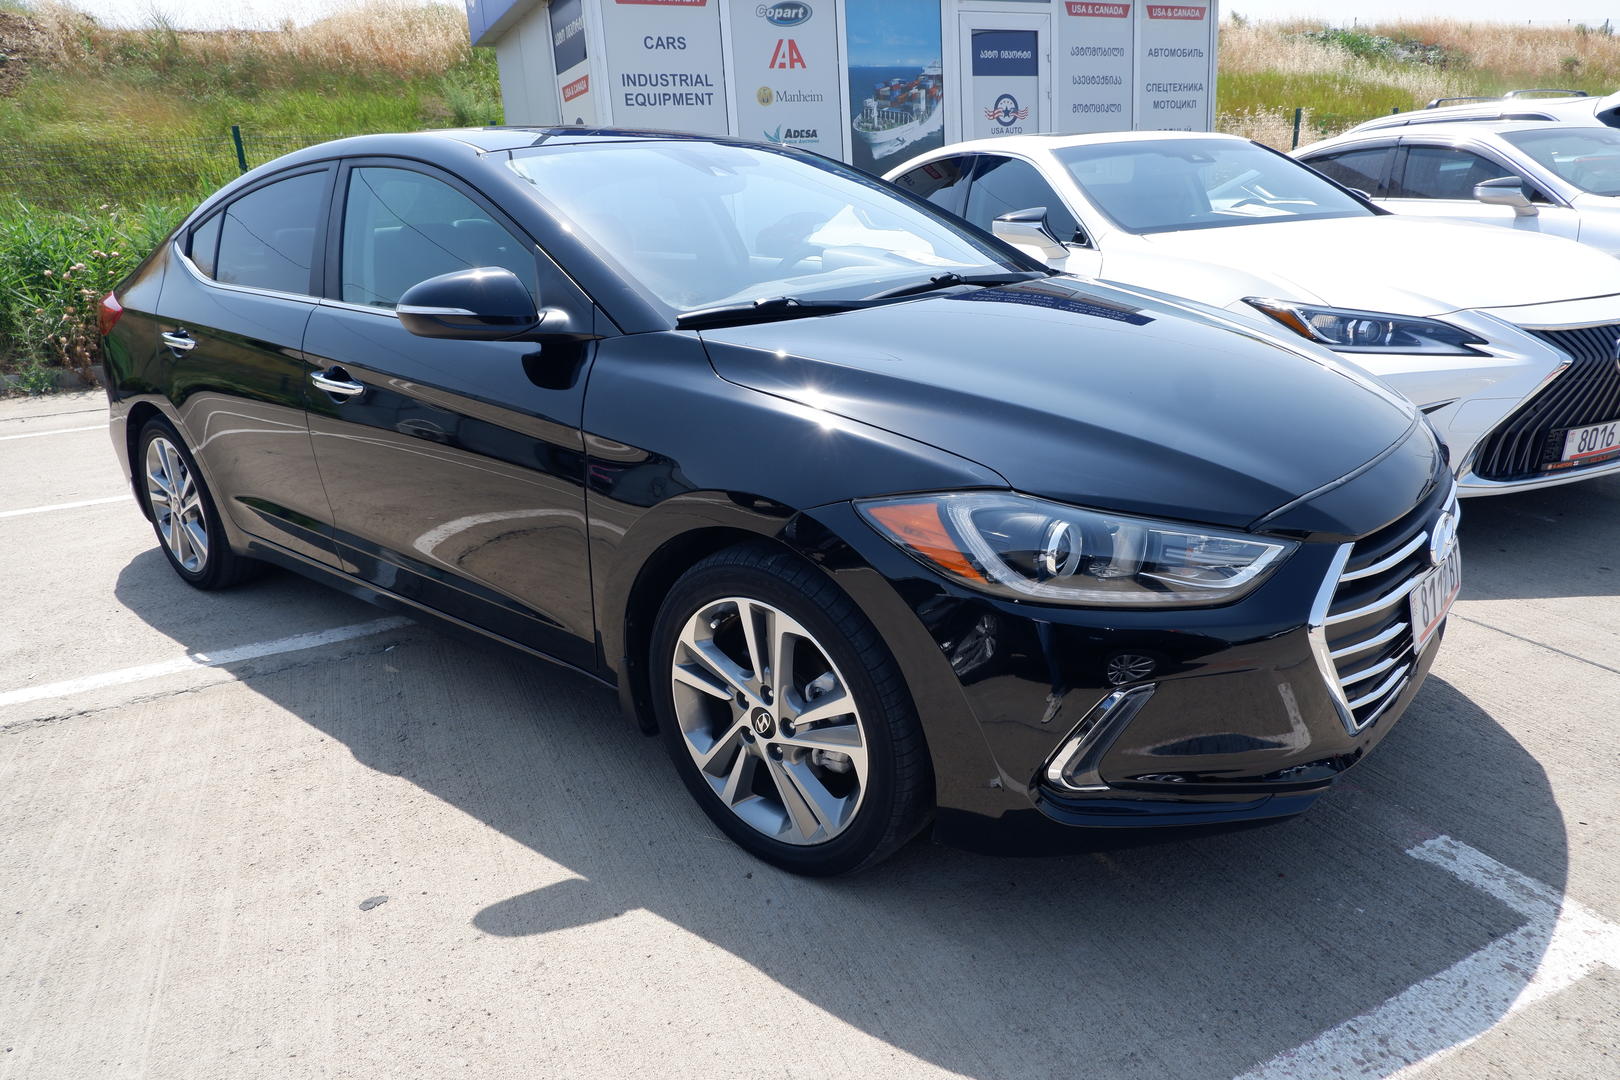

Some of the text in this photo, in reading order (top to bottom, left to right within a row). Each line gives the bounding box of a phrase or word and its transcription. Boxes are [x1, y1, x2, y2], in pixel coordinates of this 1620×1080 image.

[755, 4, 804, 19] Copart
[1071, 4, 1087, 13] USA
[1094, 5, 1124, 15] CANADA
[1152, 8, 1200, 17] USA & CANADA
[643, 36, 687, 50] CARS
[1148, 48, 1204, 58] АВТОМОБИЛЬ
[621, 74, 714, 87] INDUSTRIAL
[1146, 83, 1204, 93] СПЕЦТЕХНИКА
[624, 92, 714, 107] EQUIPMENT
[776, 90, 824, 103] Manheim
[1153, 100, 1197, 110] МОТОЦИКЛ
[1005, 127, 1023, 135] AUTO
[1577, 423, 1617, 453] 8016
